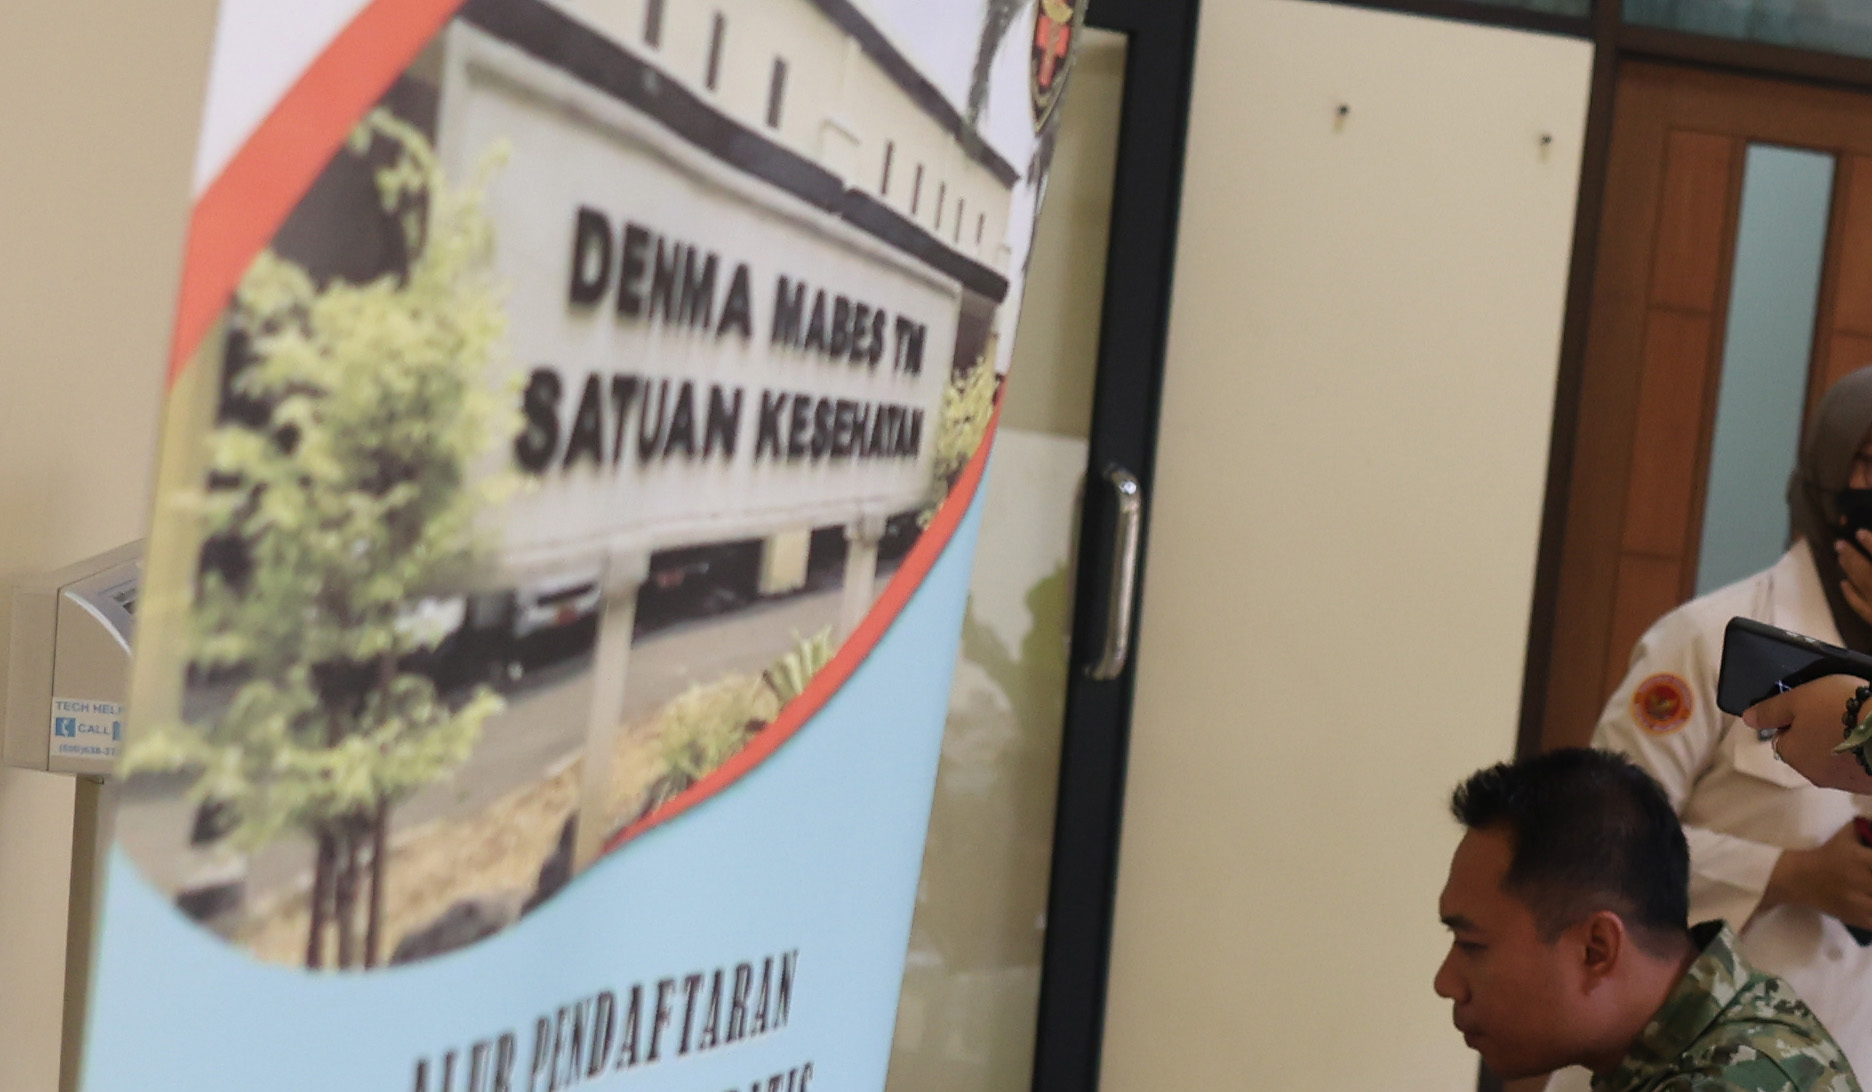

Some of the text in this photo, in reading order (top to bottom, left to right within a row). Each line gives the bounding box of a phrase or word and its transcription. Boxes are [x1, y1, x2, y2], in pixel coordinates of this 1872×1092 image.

[568, 205, 753, 342] DENMA
[771, 273, 886, 370] MABES
[515, 366, 924, 475] SATUAN KESEHATAN
[56, 701, 89, 713] TECH
[78, 723, 110, 735] CALL
